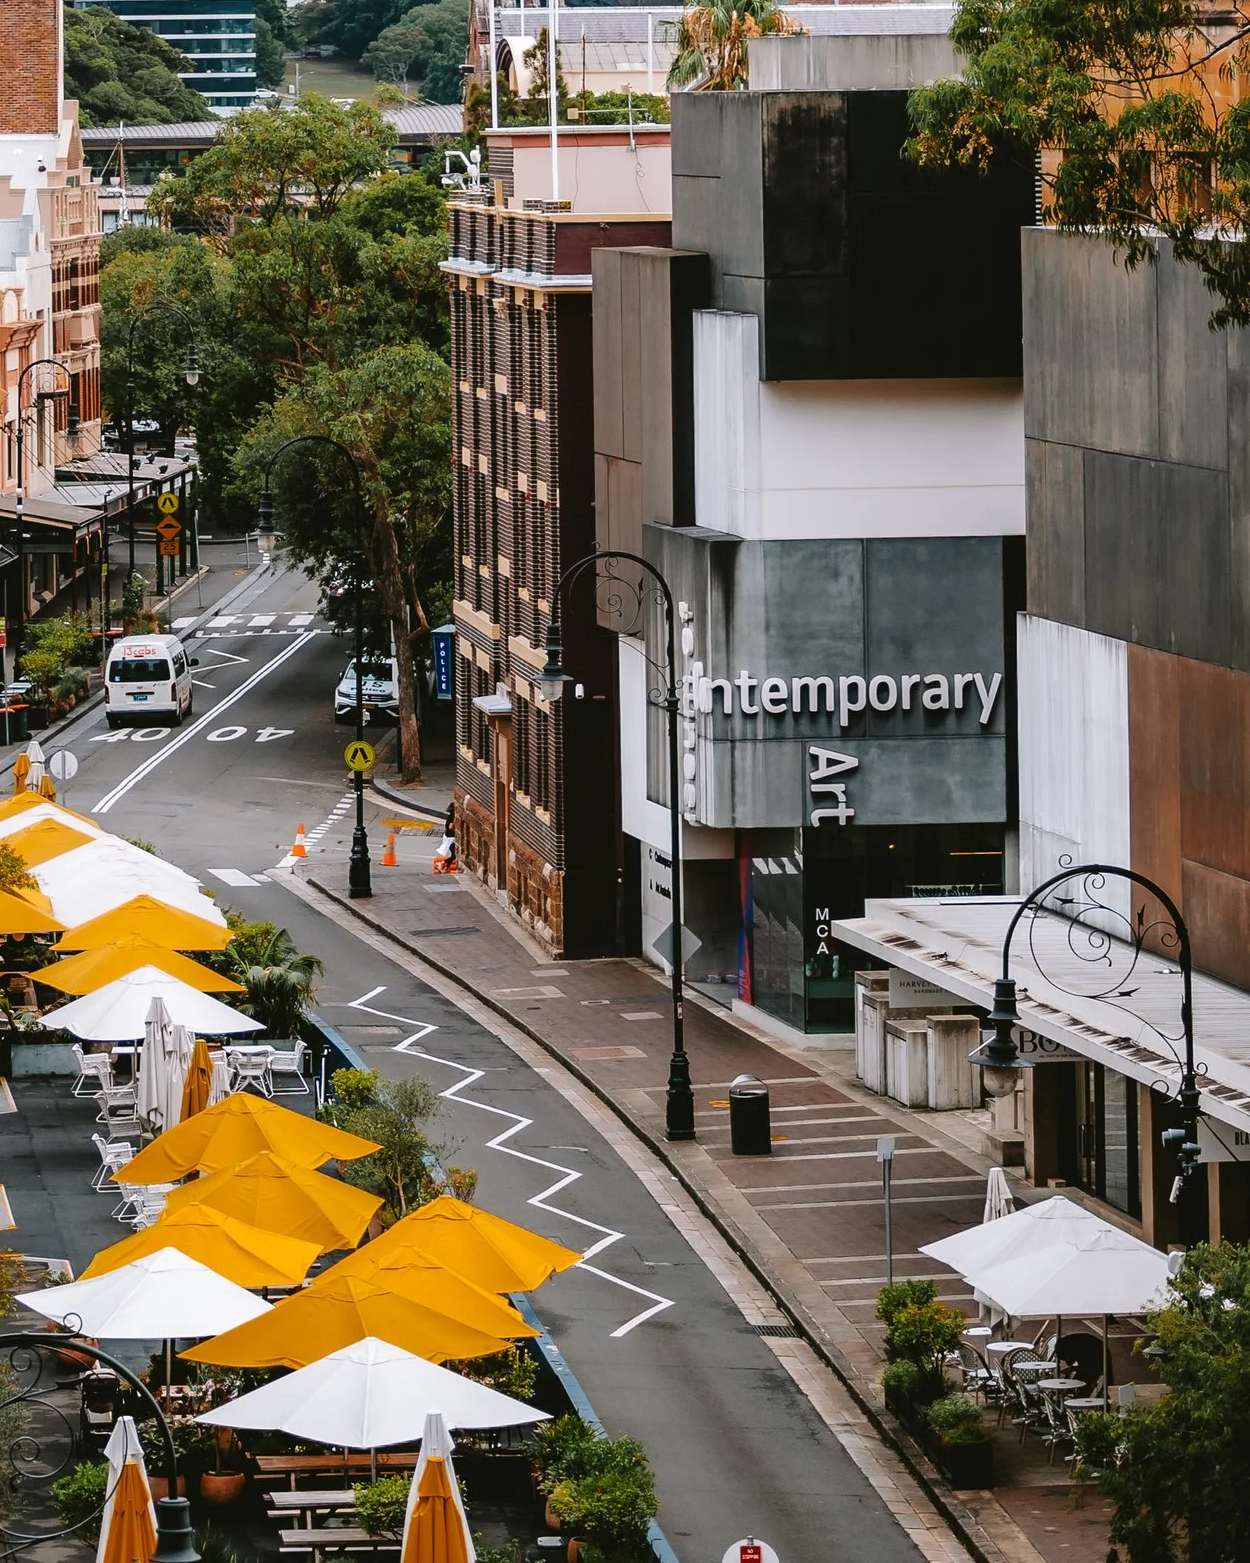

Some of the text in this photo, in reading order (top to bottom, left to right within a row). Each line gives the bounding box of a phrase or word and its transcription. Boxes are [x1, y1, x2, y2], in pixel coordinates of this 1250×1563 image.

[163, 542, 176, 551] 25
[123, 645, 157, 656] 13cabs
[439, 642, 447, 690] POLICE
[693, 660, 1002, 727] ntemporary
[88, 727, 172, 742] 40
[206, 726, 295, 742] 40
[808, 745, 859, 828] Art
[815, 907, 830, 955] MCA
[899, 980, 931, 988] HARVEY
[1019, 1030, 1068, 1054] BO
